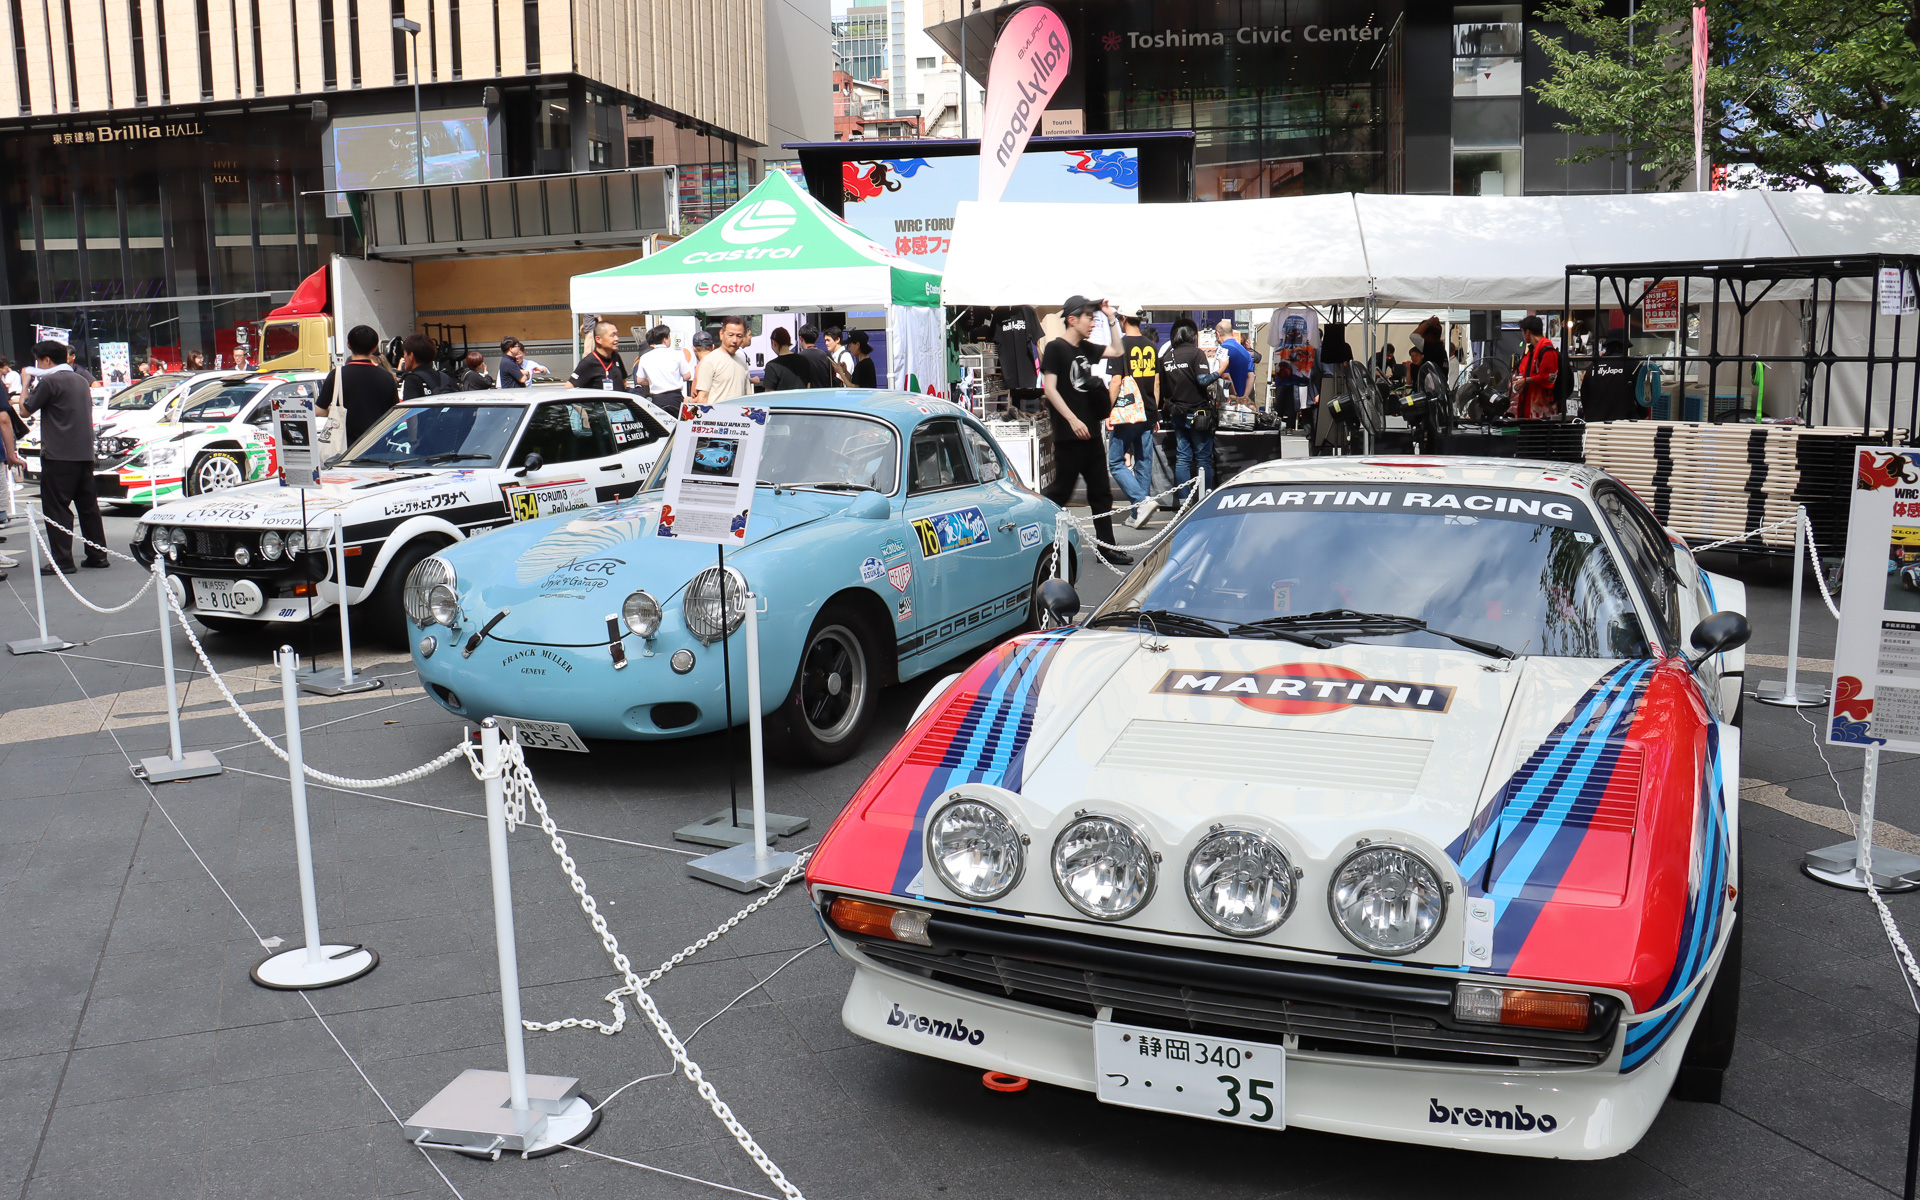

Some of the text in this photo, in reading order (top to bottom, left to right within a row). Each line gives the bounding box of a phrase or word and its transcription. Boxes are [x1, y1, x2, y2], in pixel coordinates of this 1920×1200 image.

[1128, 24, 1383, 49] Toshima Civic Center
[53, 123, 203, 145] 東京建物 Brillia HALL
[214, 175, 240, 183] HALL
[894, 219, 922, 232] WRC
[711, 283, 754, 295] Castrol
[1131, 346, 1156, 377] 22
[212, 452, 238, 464] DUNLOP
[538, 489, 568, 503] FORUM8
[1895, 488, 1919, 499] WRC
[517, 493, 539, 520] 54
[1217, 491, 1574, 522] MARTINI RACING
[261, 518, 303, 526] TOYOTA
[912, 518, 939, 556] 76
[889, 565, 911, 590] HEUER
[278, 608, 297, 618] apr
[925, 595, 1017, 644] PORSCHE
[502, 648, 573, 674] FRANCK MULLER
[520, 667, 547, 676] GENEVE
[1173, 674, 1435, 706] MARTINI
[519, 730, 581, 750] 85-51
[886, 1003, 985, 1046] brembo
[1429, 1098, 1557, 1133] brembo
